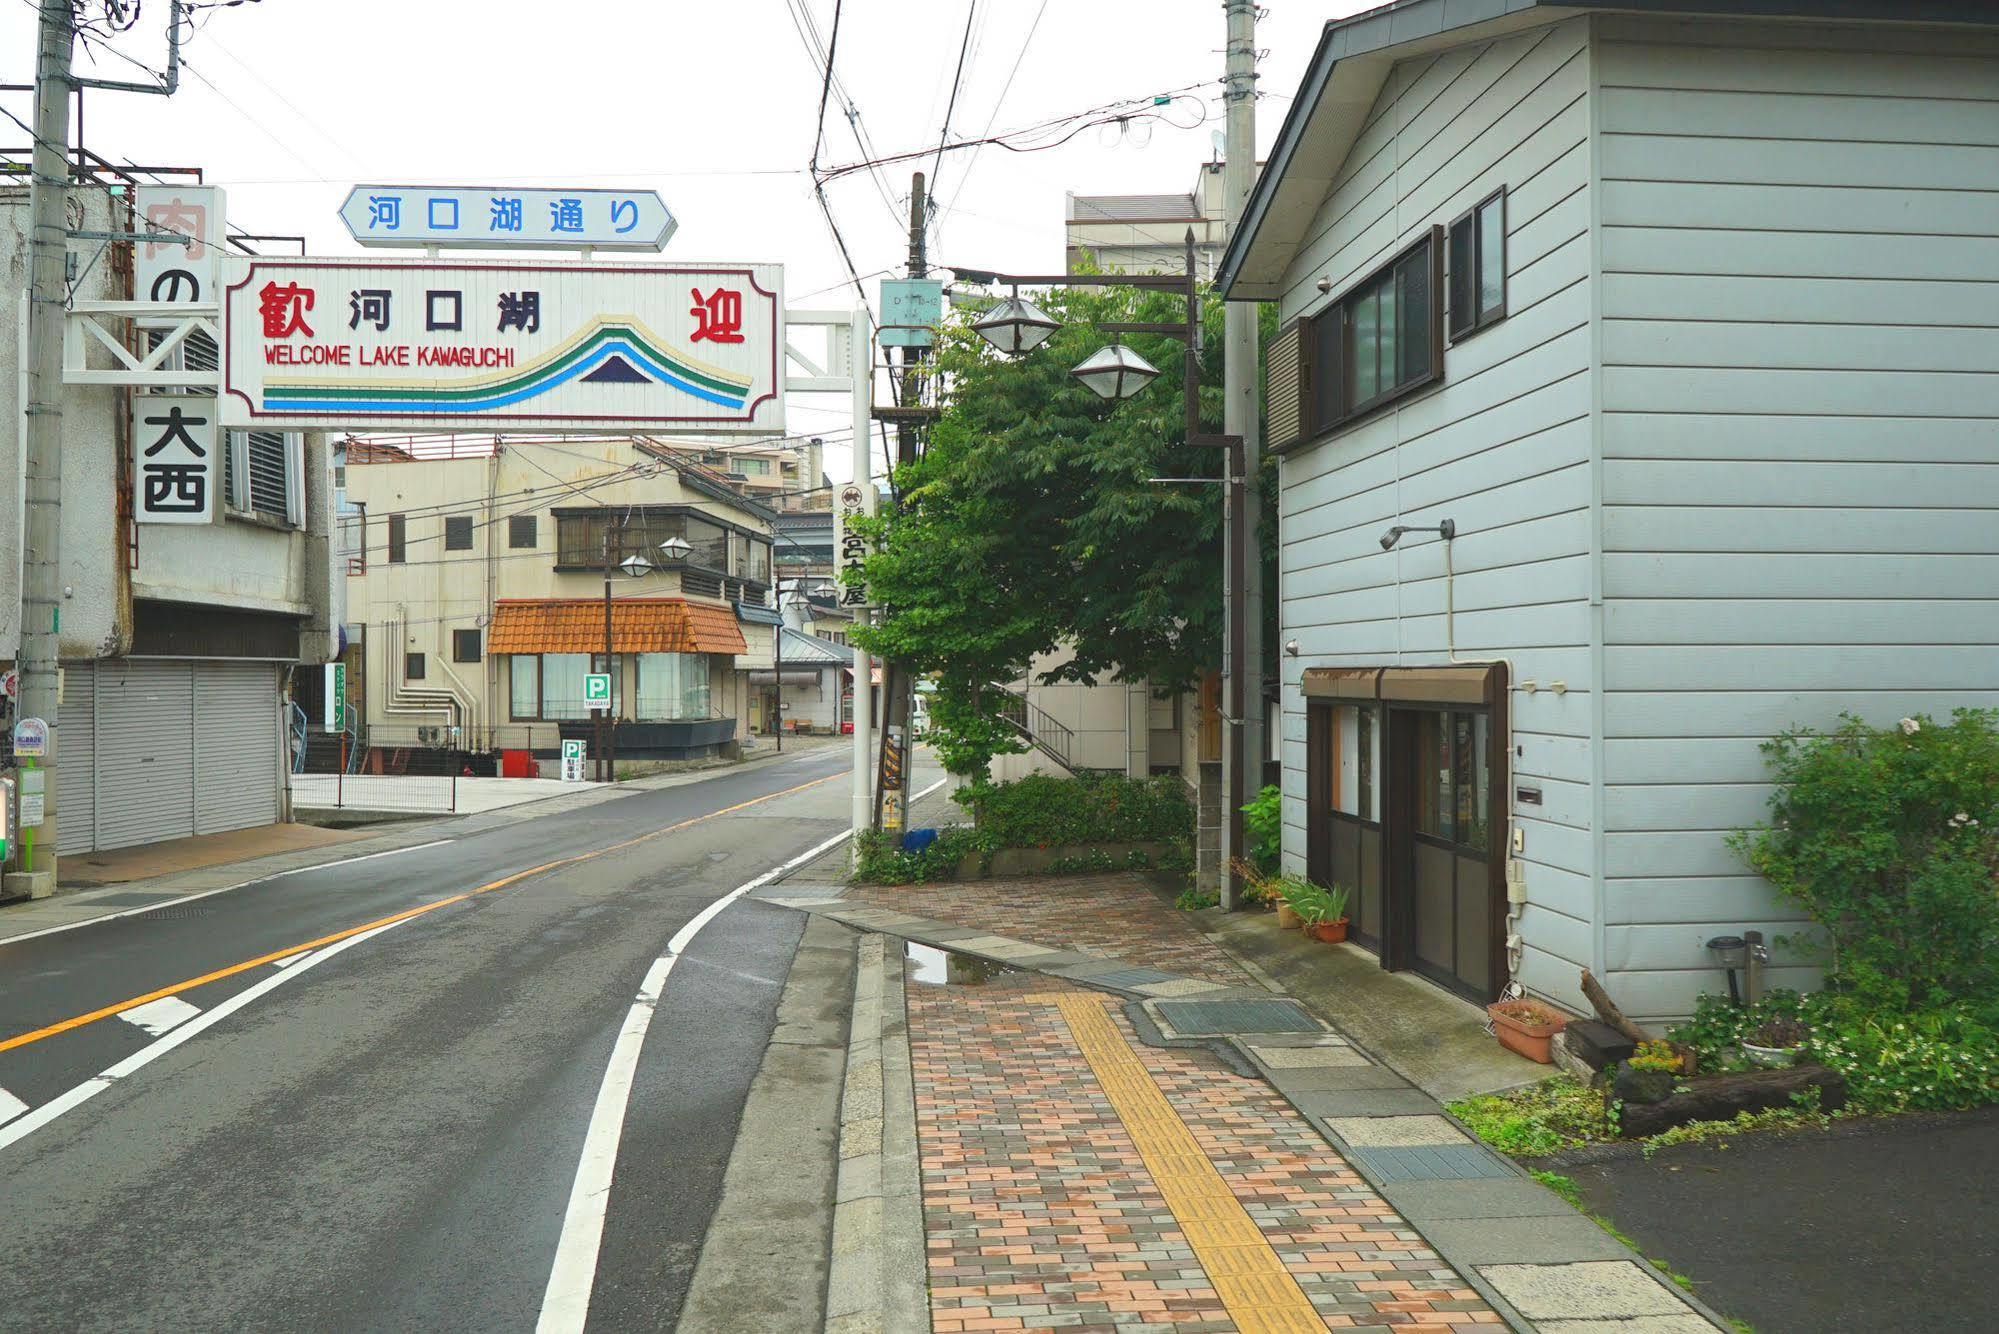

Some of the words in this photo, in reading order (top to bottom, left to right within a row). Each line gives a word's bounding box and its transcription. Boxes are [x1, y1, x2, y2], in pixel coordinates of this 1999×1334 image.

[367, 195, 640, 234] 河口湖通り
[258, 280, 315, 338] 歓
[349, 289, 540, 333] 河口湖
[689, 287, 745, 344] 迎
[264, 344, 351, 366] WELCOME
[359, 345, 409, 367] LAKE
[417, 346, 515, 368] KAWAGUCHI
[143, 406, 208, 513] 大西
[589, 678, 606, 698] P
[566, 743, 578, 758] P
